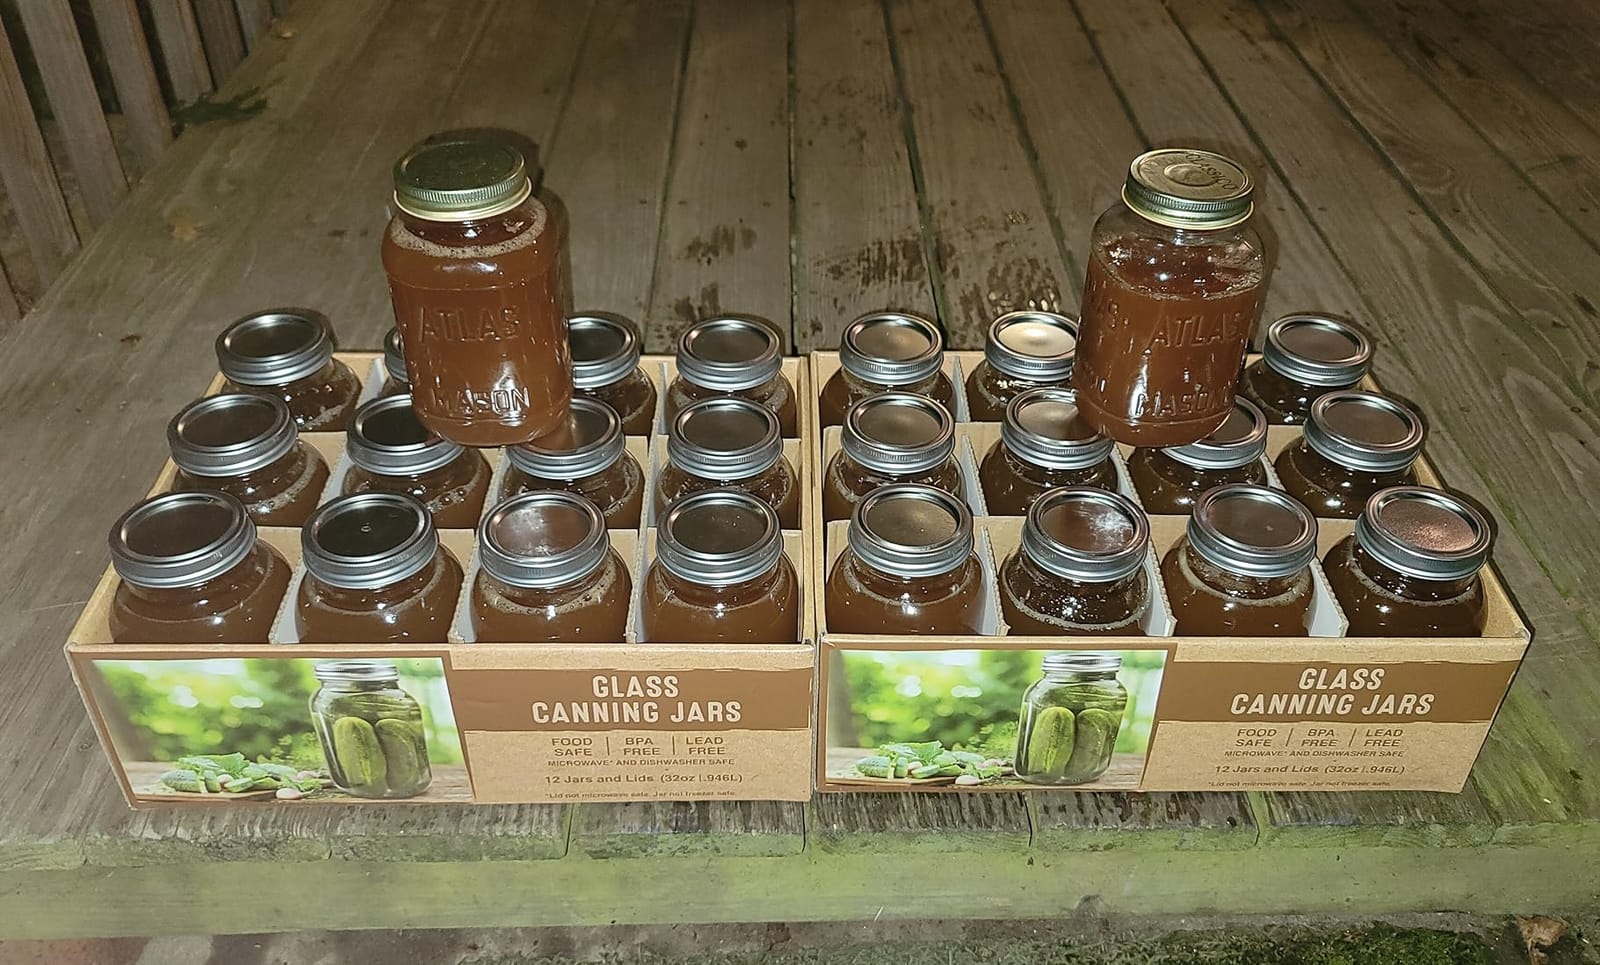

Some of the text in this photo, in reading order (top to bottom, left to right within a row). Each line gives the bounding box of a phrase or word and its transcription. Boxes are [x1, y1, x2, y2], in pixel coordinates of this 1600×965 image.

[419, 304, 521, 342] ATLAS
[1147, 311, 1241, 348] ATLAS
[1298, 667, 1386, 691] GLASS
[592, 675, 680, 699] GLASS
[1229, 693, 1435, 716] CANNING JARS
[531, 700, 742, 724] CANNING JARS
[1237, 728, 1277, 737] FOOD
[1307, 728, 1335, 737] BPA
[1365, 728, 1404, 737] LEAD
[551, 737, 593, 746] FOOD
[625, 737, 654, 746] BPA
[685, 736, 724, 745] LEAD
[1235, 738, 1273, 747] SAFE
[1301, 739, 1339, 747] FREE
[1363, 739, 1401, 747] FREE
[554, 748, 593, 757] SAFE
[623, 747, 661, 756] FREE
[688, 746, 726, 755] FREE
[1379, 750, 1405, 758] SAFE
[708, 758, 736, 766] SAFE
[1215, 765, 1231, 773] 12
[1232, 765, 1261, 773] Jars
[1263, 765, 1289, 773] and
[1291, 765, 1320, 773] Lids
[1324, 765, 1360, 774] (32oz
[545, 775, 561, 784] 12
[564, 775, 593, 784] Jars
[597, 774, 621, 783] and
[626, 774, 654, 783] Lids
[660, 773, 696, 784] (32oz
